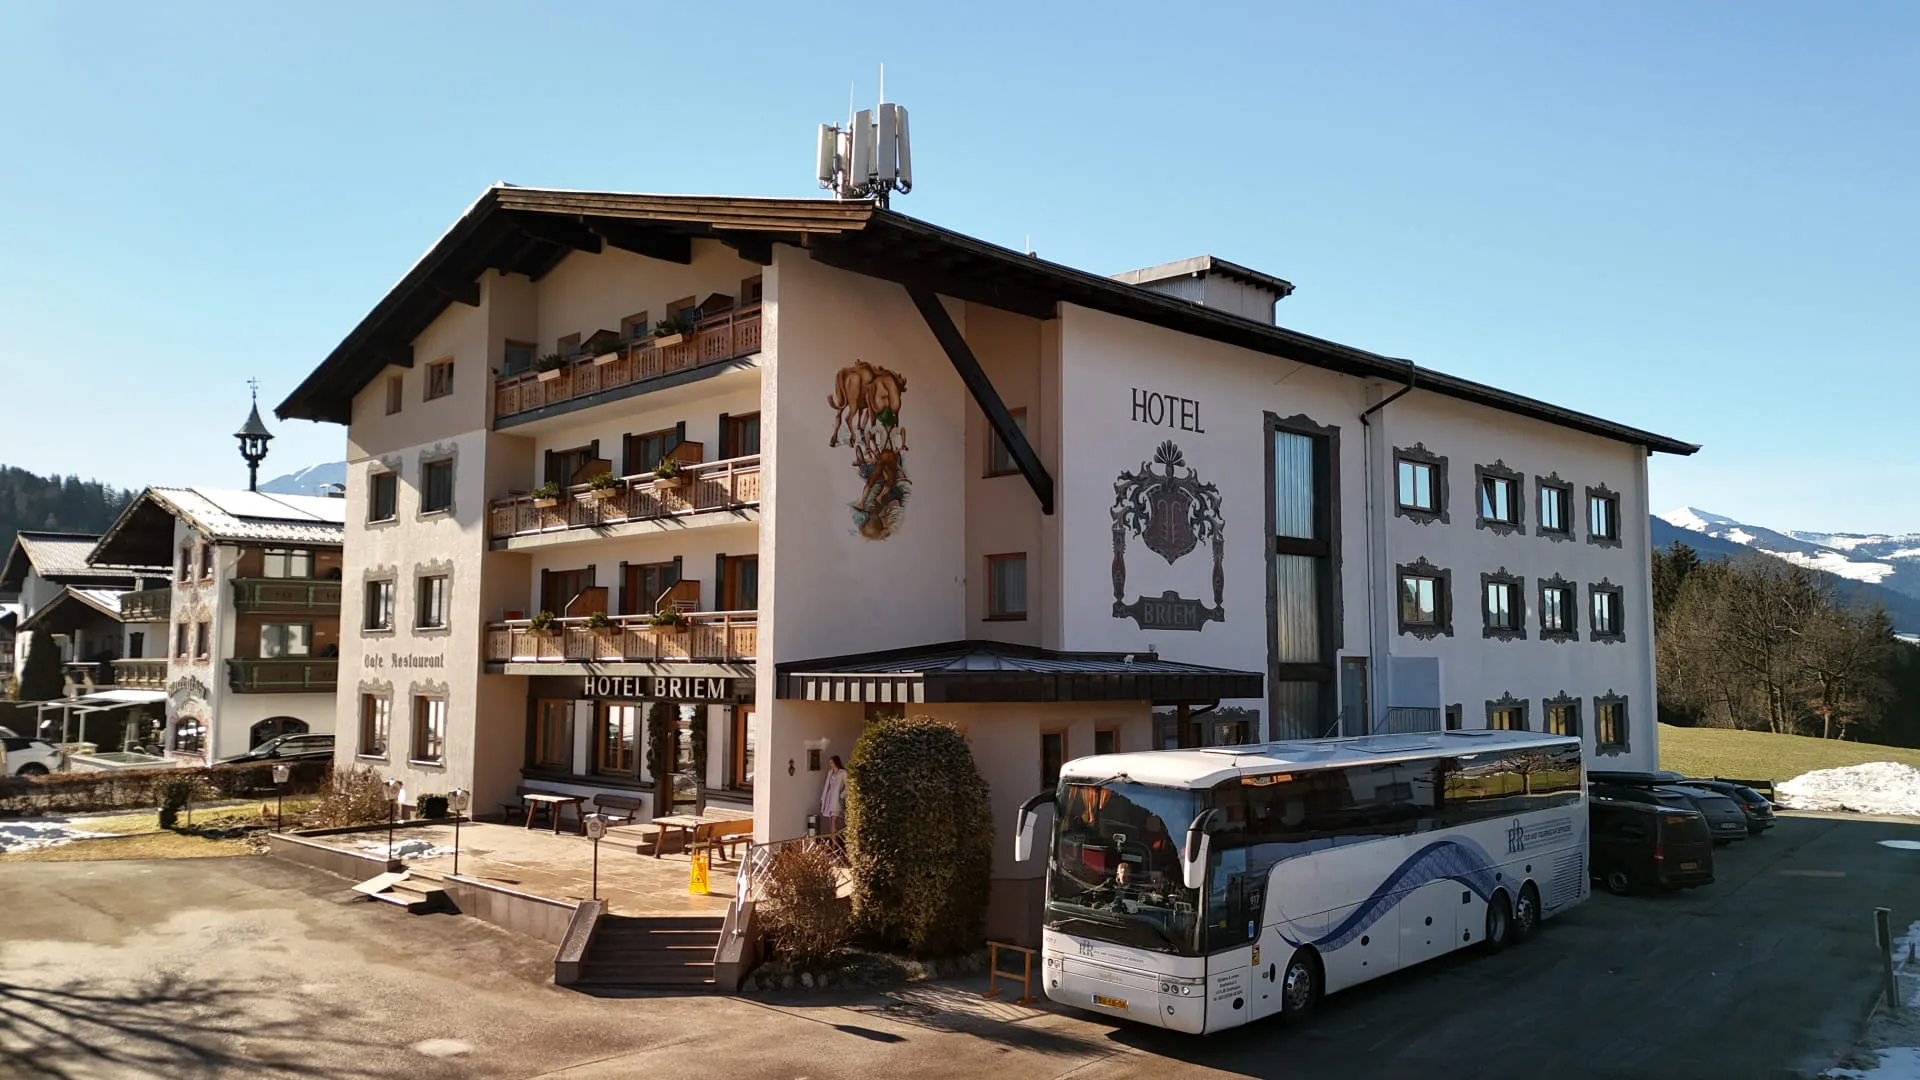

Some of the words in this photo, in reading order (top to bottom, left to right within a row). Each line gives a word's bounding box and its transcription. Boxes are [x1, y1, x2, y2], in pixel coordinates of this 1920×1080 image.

[1131, 387, 1205, 434] HOTEL
[1144, 602, 1197, 625] BRIEM
[391, 652, 444, 669] Restaurant
[584, 676, 644, 697] HOTEL
[654, 677, 725, 699] BRIEM
